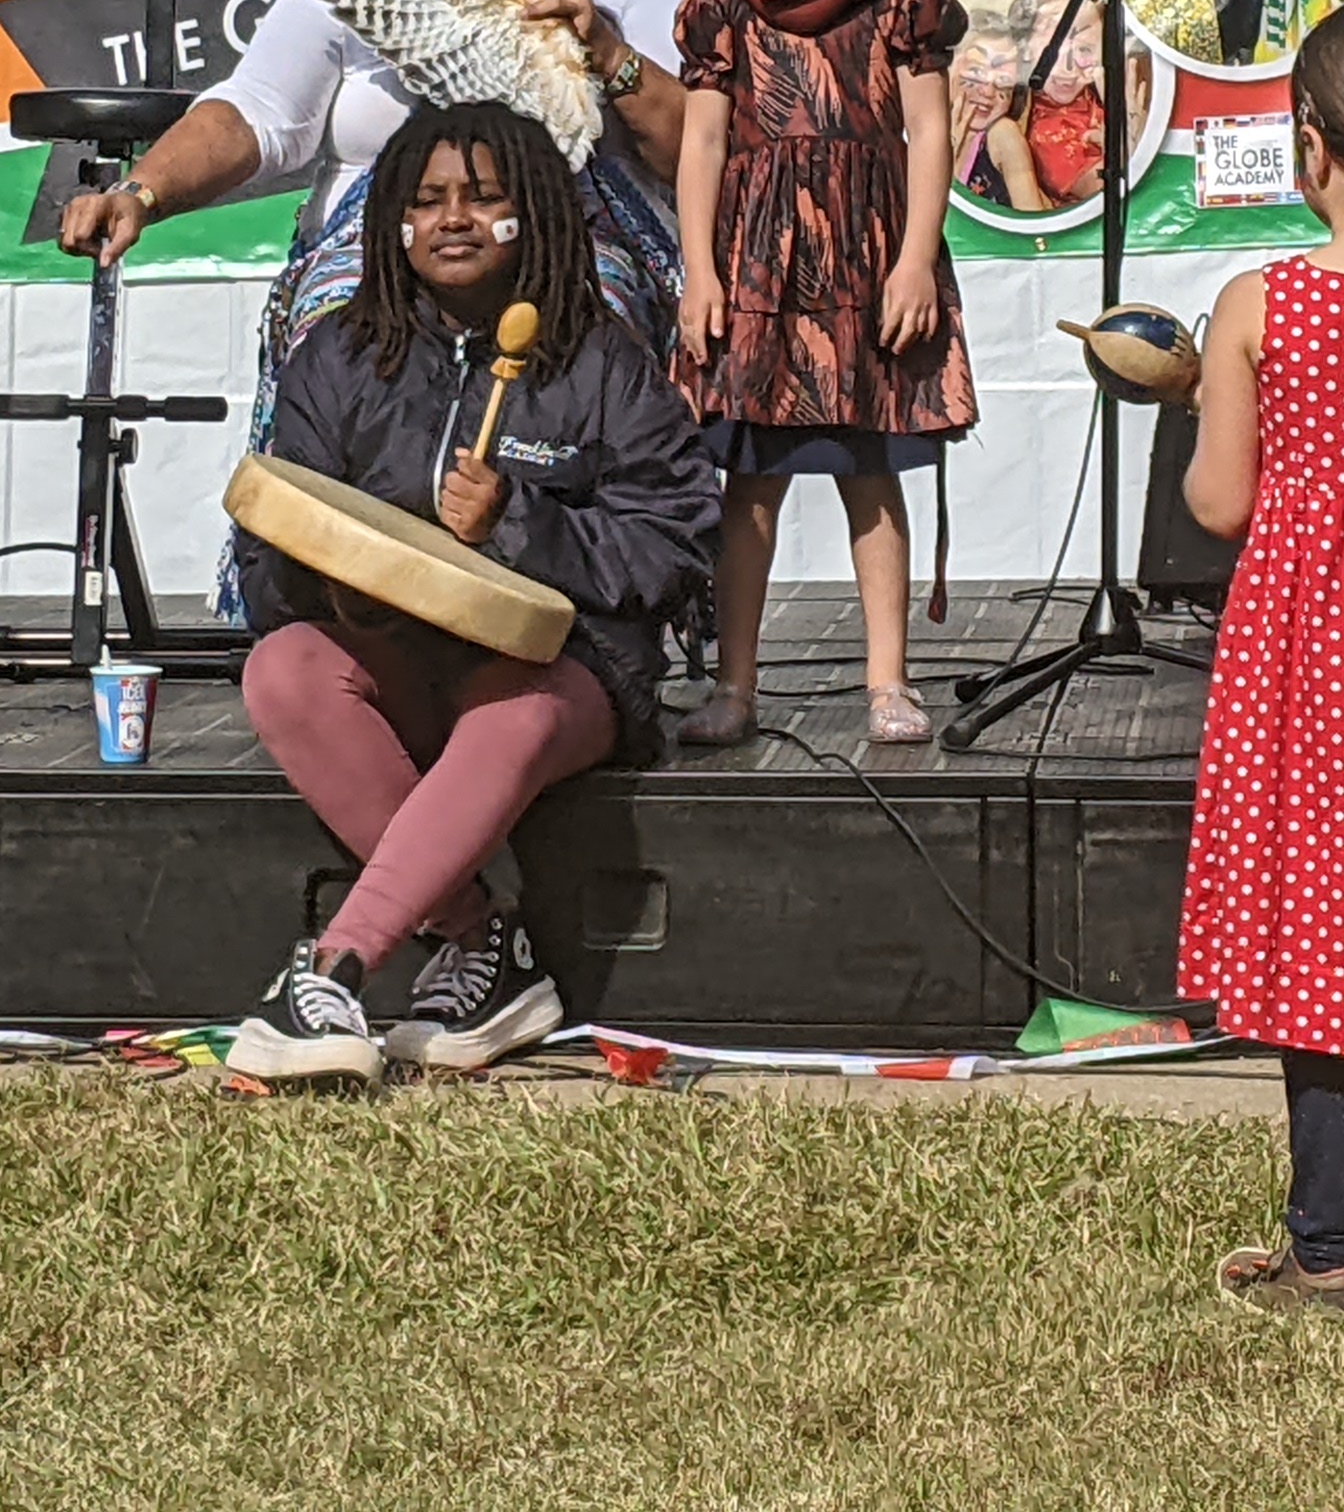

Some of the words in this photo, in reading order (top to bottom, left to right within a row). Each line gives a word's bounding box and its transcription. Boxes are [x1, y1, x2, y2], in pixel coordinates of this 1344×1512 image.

[1212, 134, 1238, 149] THE
[1215, 148, 1284, 170] GLOBE
[1214, 169, 1284, 186] ACADEMY
